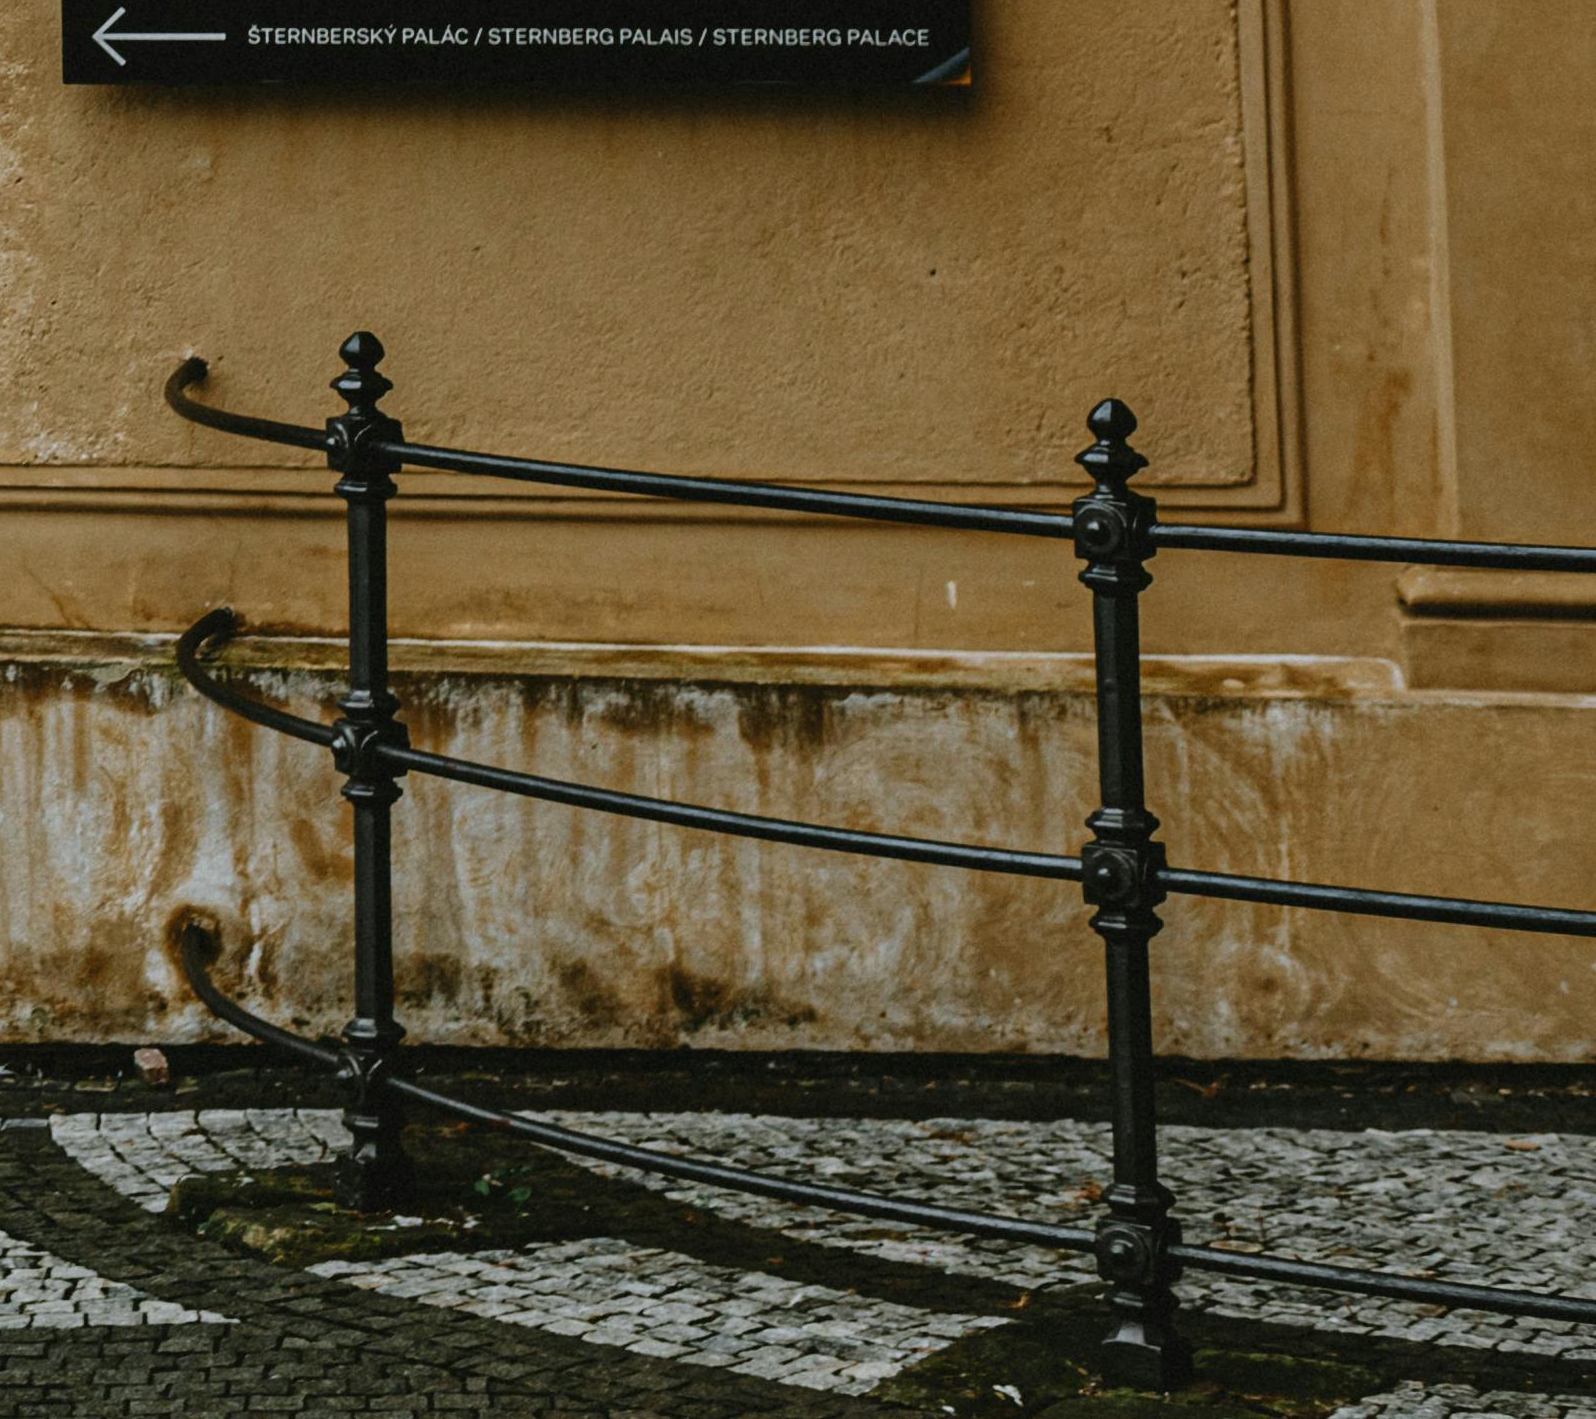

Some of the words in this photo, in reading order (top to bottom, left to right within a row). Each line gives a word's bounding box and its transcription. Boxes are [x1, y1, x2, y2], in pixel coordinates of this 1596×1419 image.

[247, 24, 397, 45] ŠTERNBERSKÝ
[401, 24, 469, 45] PALÁC
[473, 27, 483, 46] /
[488, 27, 615, 46] STERNBERG
[619, 27, 693, 46] PALAIS
[698, 28, 708, 47] /
[712, 28, 842, 46] STERNBERG
[847, 28, 929, 47] PALACE
